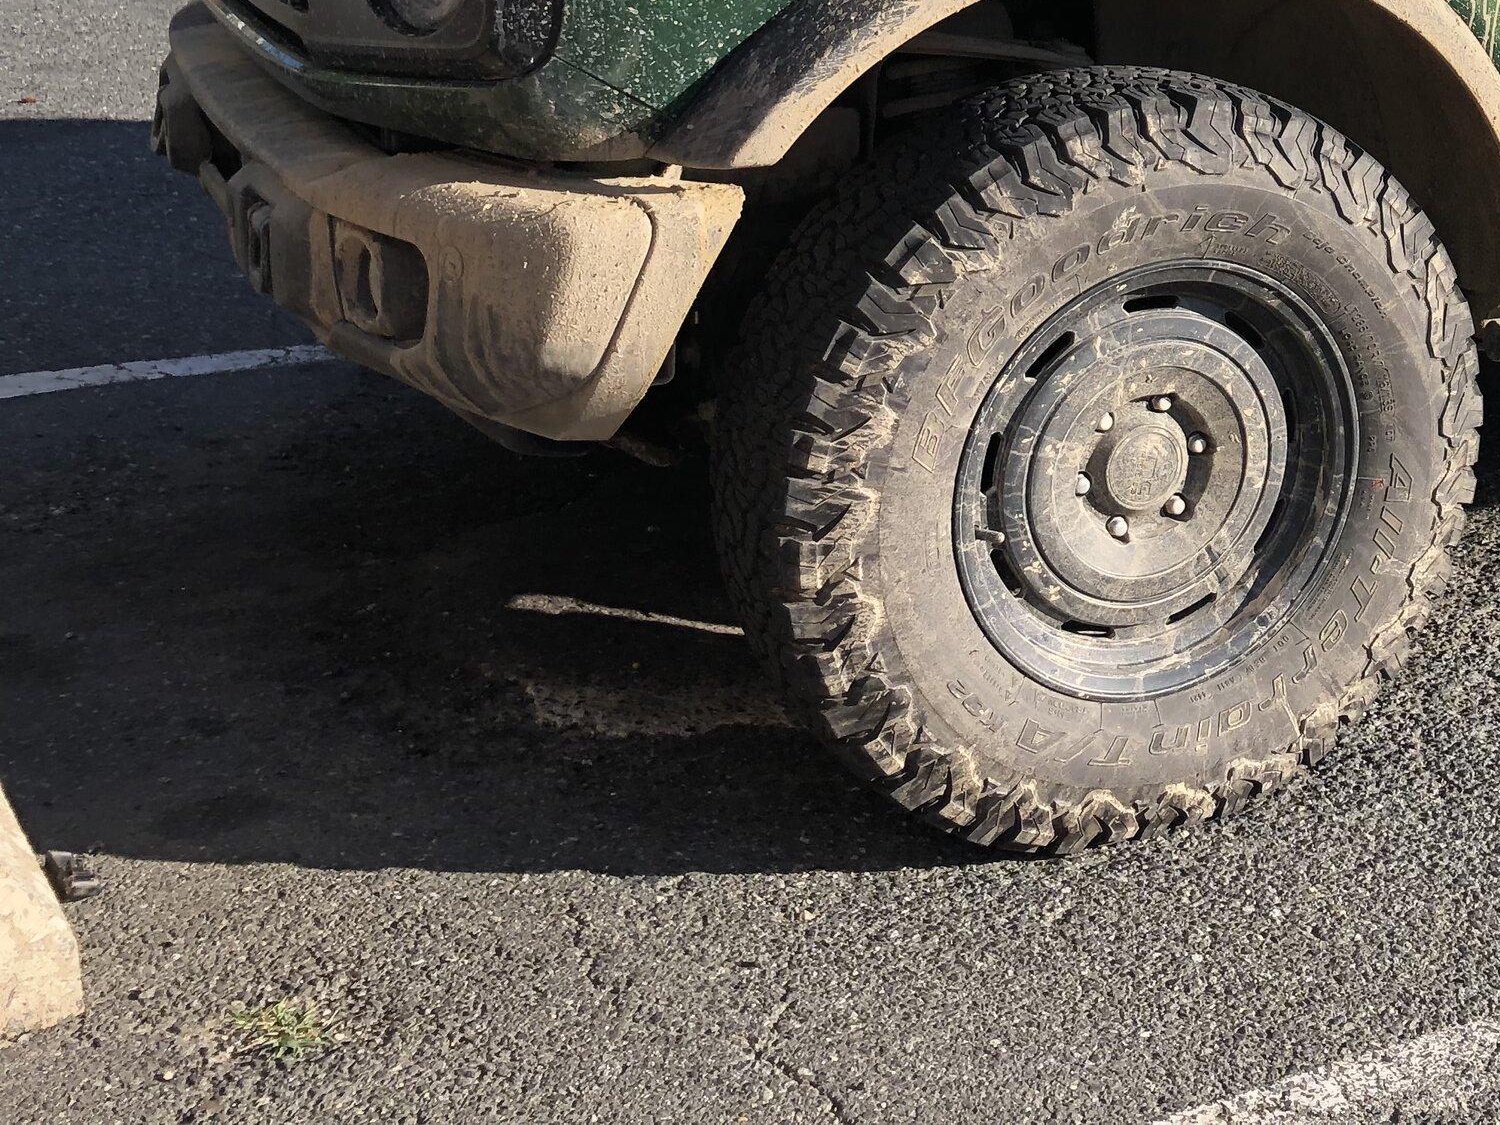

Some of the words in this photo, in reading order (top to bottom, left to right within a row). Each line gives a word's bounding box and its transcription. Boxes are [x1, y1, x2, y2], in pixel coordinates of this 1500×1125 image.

[911, 204, 1293, 474] BFGoodrich
[1148, 453, 1414, 756] All-Terrain
[1015, 717, 1133, 767] T/A
